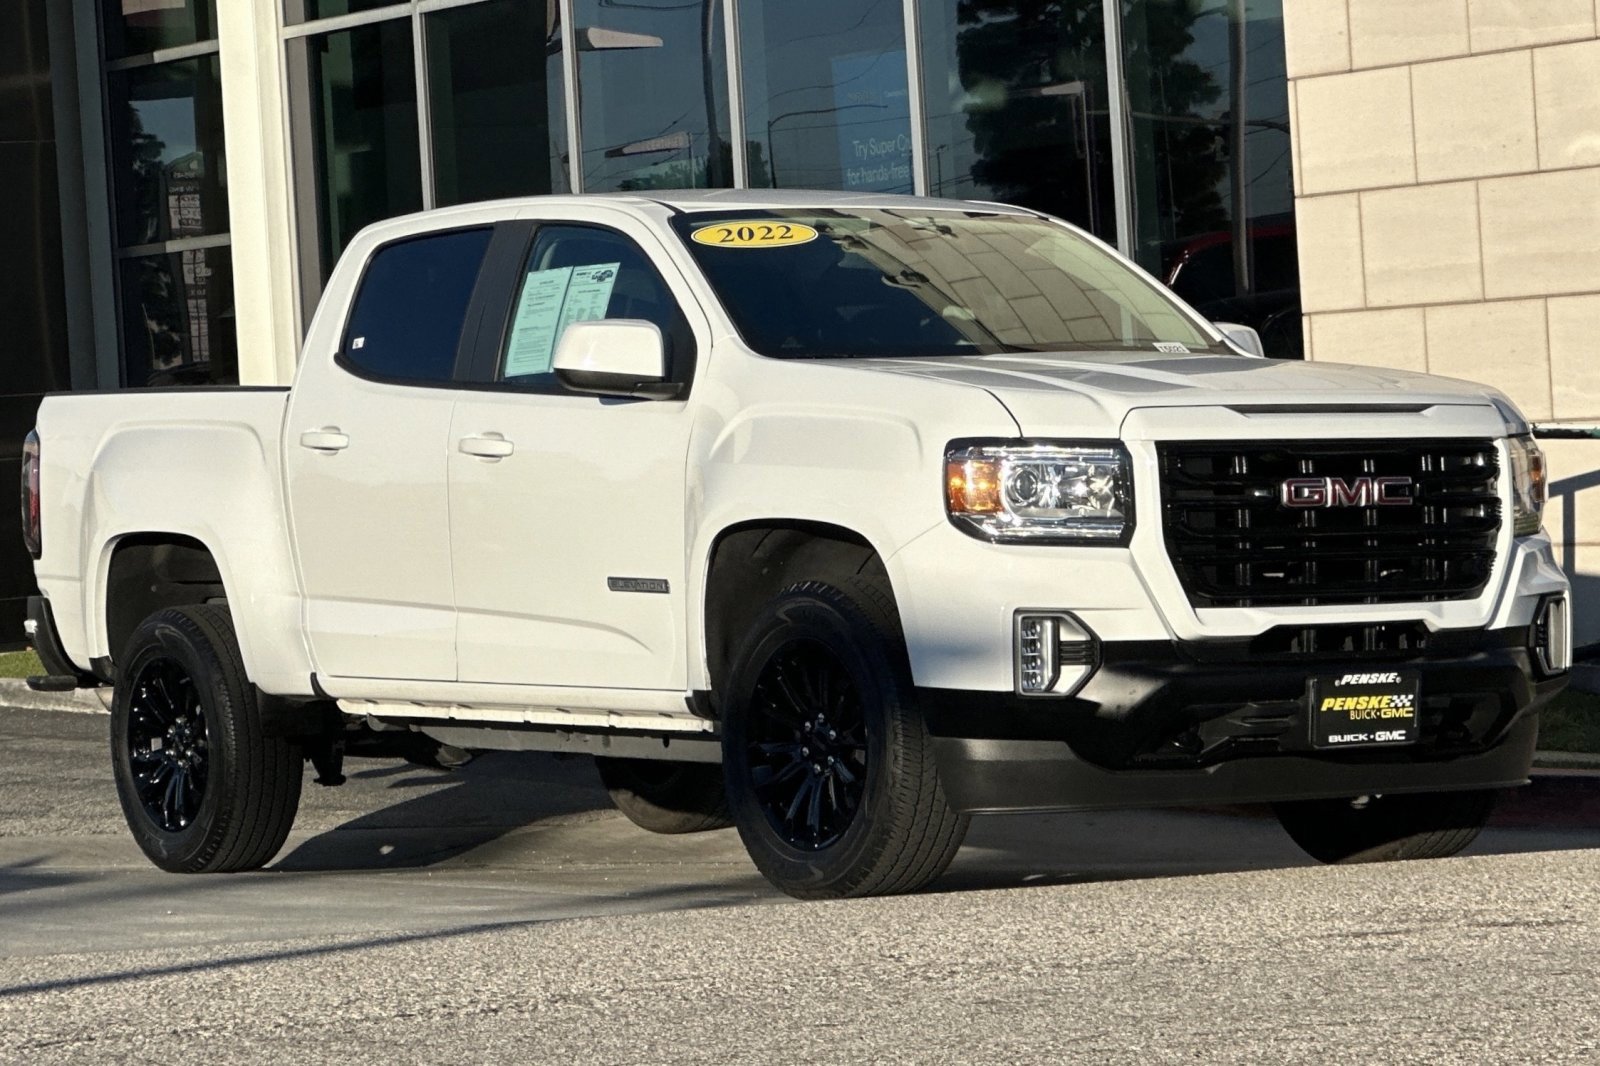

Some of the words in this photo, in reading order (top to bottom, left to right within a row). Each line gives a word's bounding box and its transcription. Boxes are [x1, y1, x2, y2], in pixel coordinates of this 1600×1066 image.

[852, 140, 868, 160] Try
[869, 137, 896, 157] Super
[847, 168, 860, 185] for
[716, 225, 794, 243] 2022
[1281, 476, 1413, 508] GMC
[1340, 672, 1398, 685] PENSKE
[1320, 695, 1393, 711] PENSKE
[1328, 733, 1368, 743] BUICK
[1375, 730, 1406, 741] GMC
